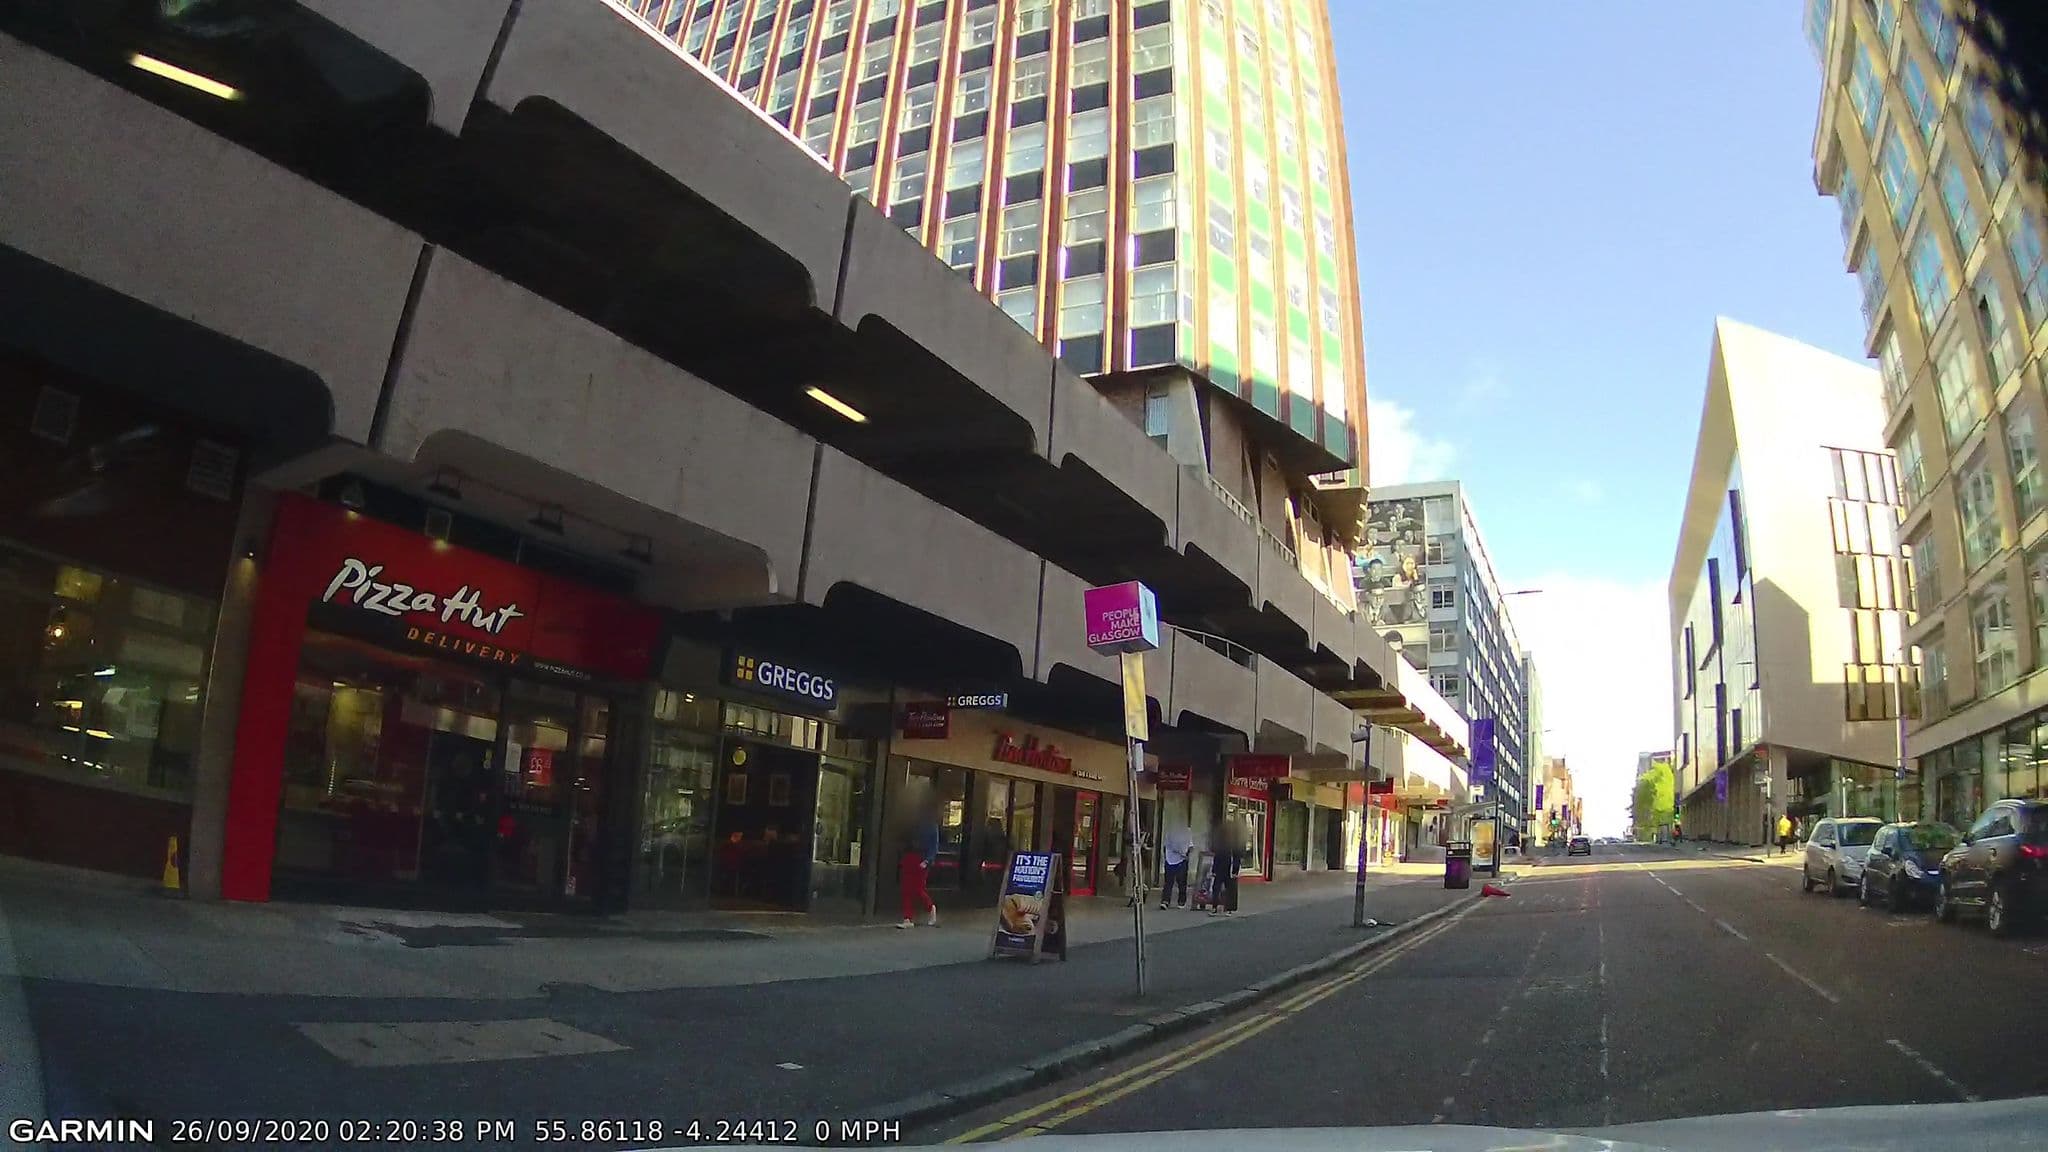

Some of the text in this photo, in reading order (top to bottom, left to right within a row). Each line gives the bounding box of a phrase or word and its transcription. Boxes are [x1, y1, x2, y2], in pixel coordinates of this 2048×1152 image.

[322, 558, 524, 634] Pizza Hut
[1102, 607, 1140, 621] PEOPLE
[1110, 613, 1139, 630] MAKE
[1088, 627, 1140, 642] GLASGOW
[406, 627, 521, 665] DELIVERY
[757, 661, 833, 700] GREGGS
[957, 695, 1001, 707] GREGGS
[1032, 855, 1049, 867] THE
